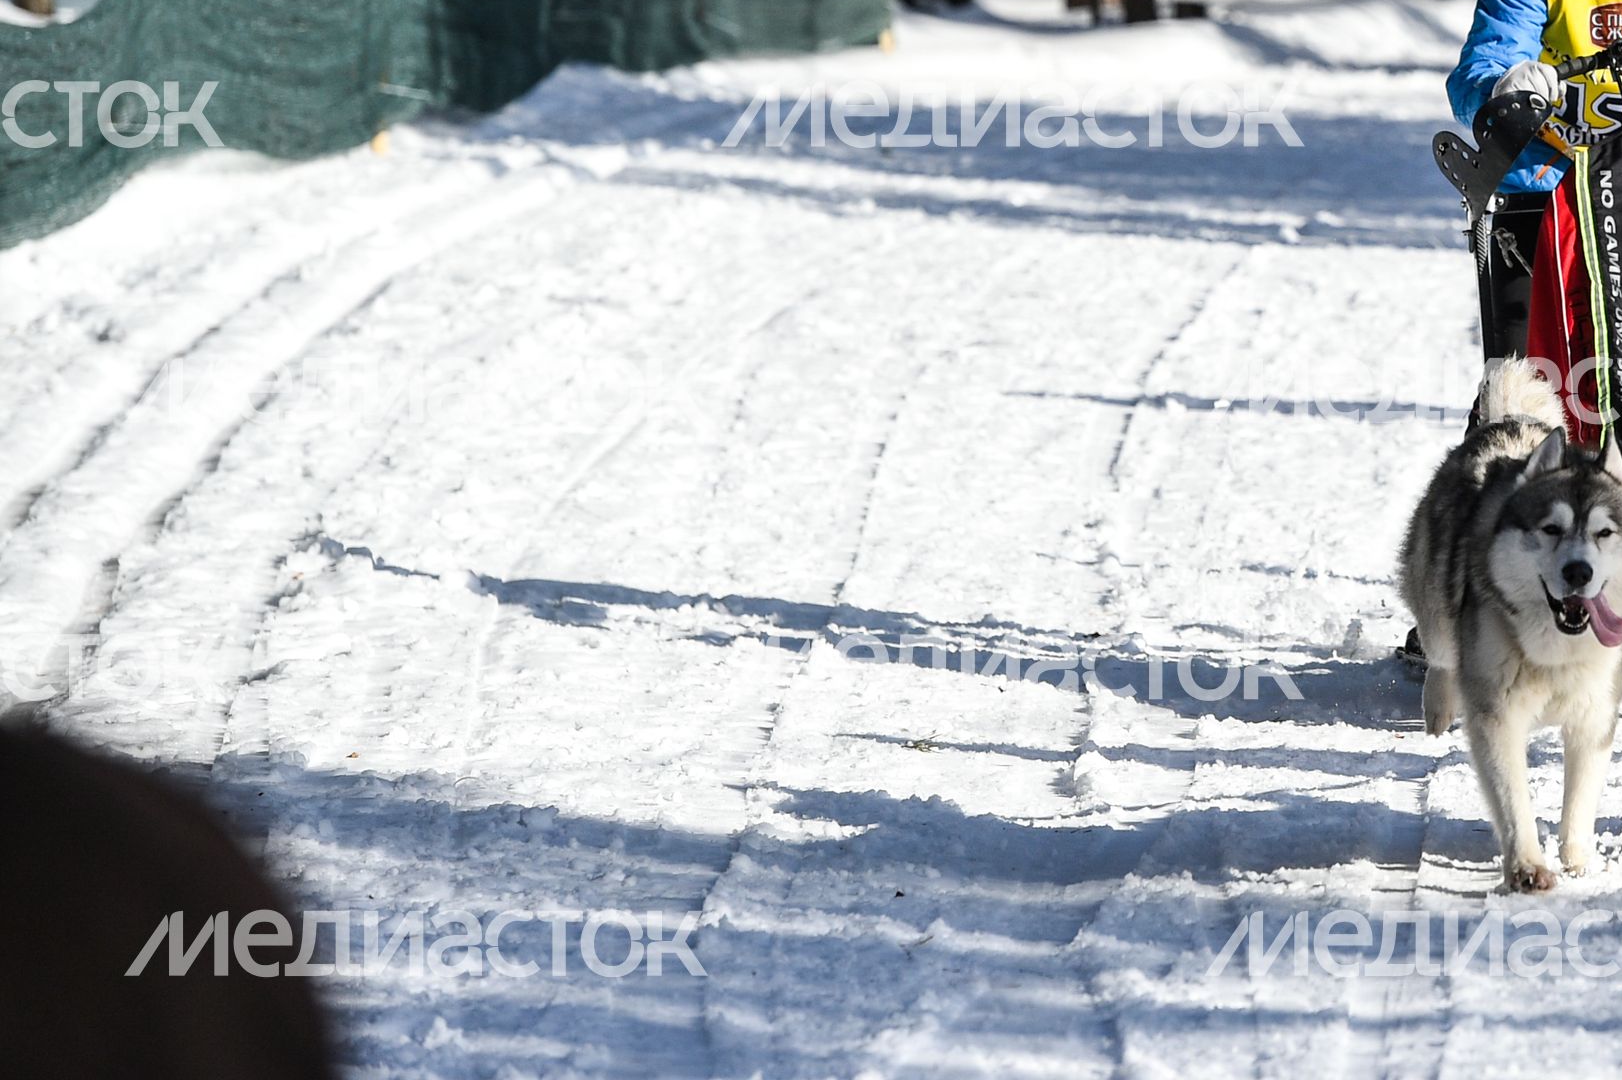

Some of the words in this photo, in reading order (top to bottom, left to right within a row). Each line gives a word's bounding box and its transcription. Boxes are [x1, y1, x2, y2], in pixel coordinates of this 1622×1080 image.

[1591, 13, 1603, 27] С
[1591, 27, 1603, 40] С
[1600, 169, 1614, 209] NO
